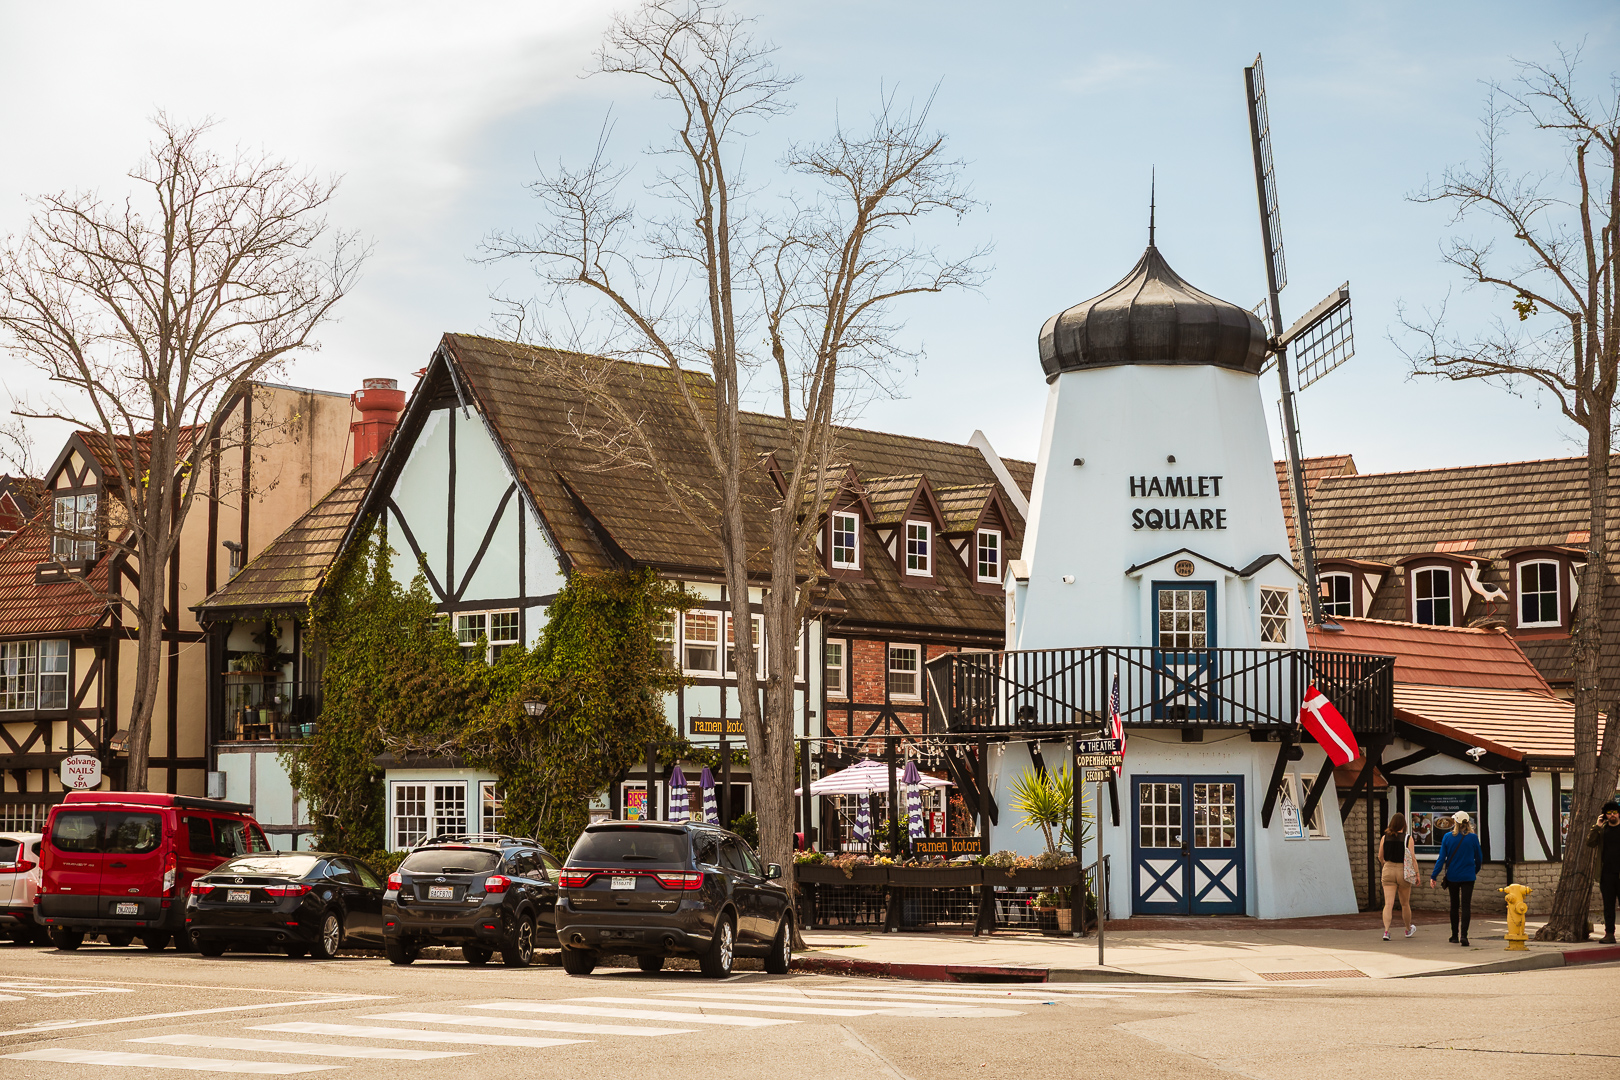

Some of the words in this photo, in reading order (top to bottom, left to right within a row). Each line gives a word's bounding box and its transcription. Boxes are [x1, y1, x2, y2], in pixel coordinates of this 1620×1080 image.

[1130, 476, 1223, 498] HAMLET
[1132, 508, 1227, 530] SQUARE
[694, 720, 722, 732] ramen
[726, 720, 744, 732] koto
[1088, 740, 1116, 752] THEATRE
[66, 758, 96, 767] Solvang
[1077, 756, 1116, 766] COPENHAGEN
[1086, 770, 1104, 781] SECOND
[916, 842, 948, 852] ramen
[951, 839, 982, 852] kotori
